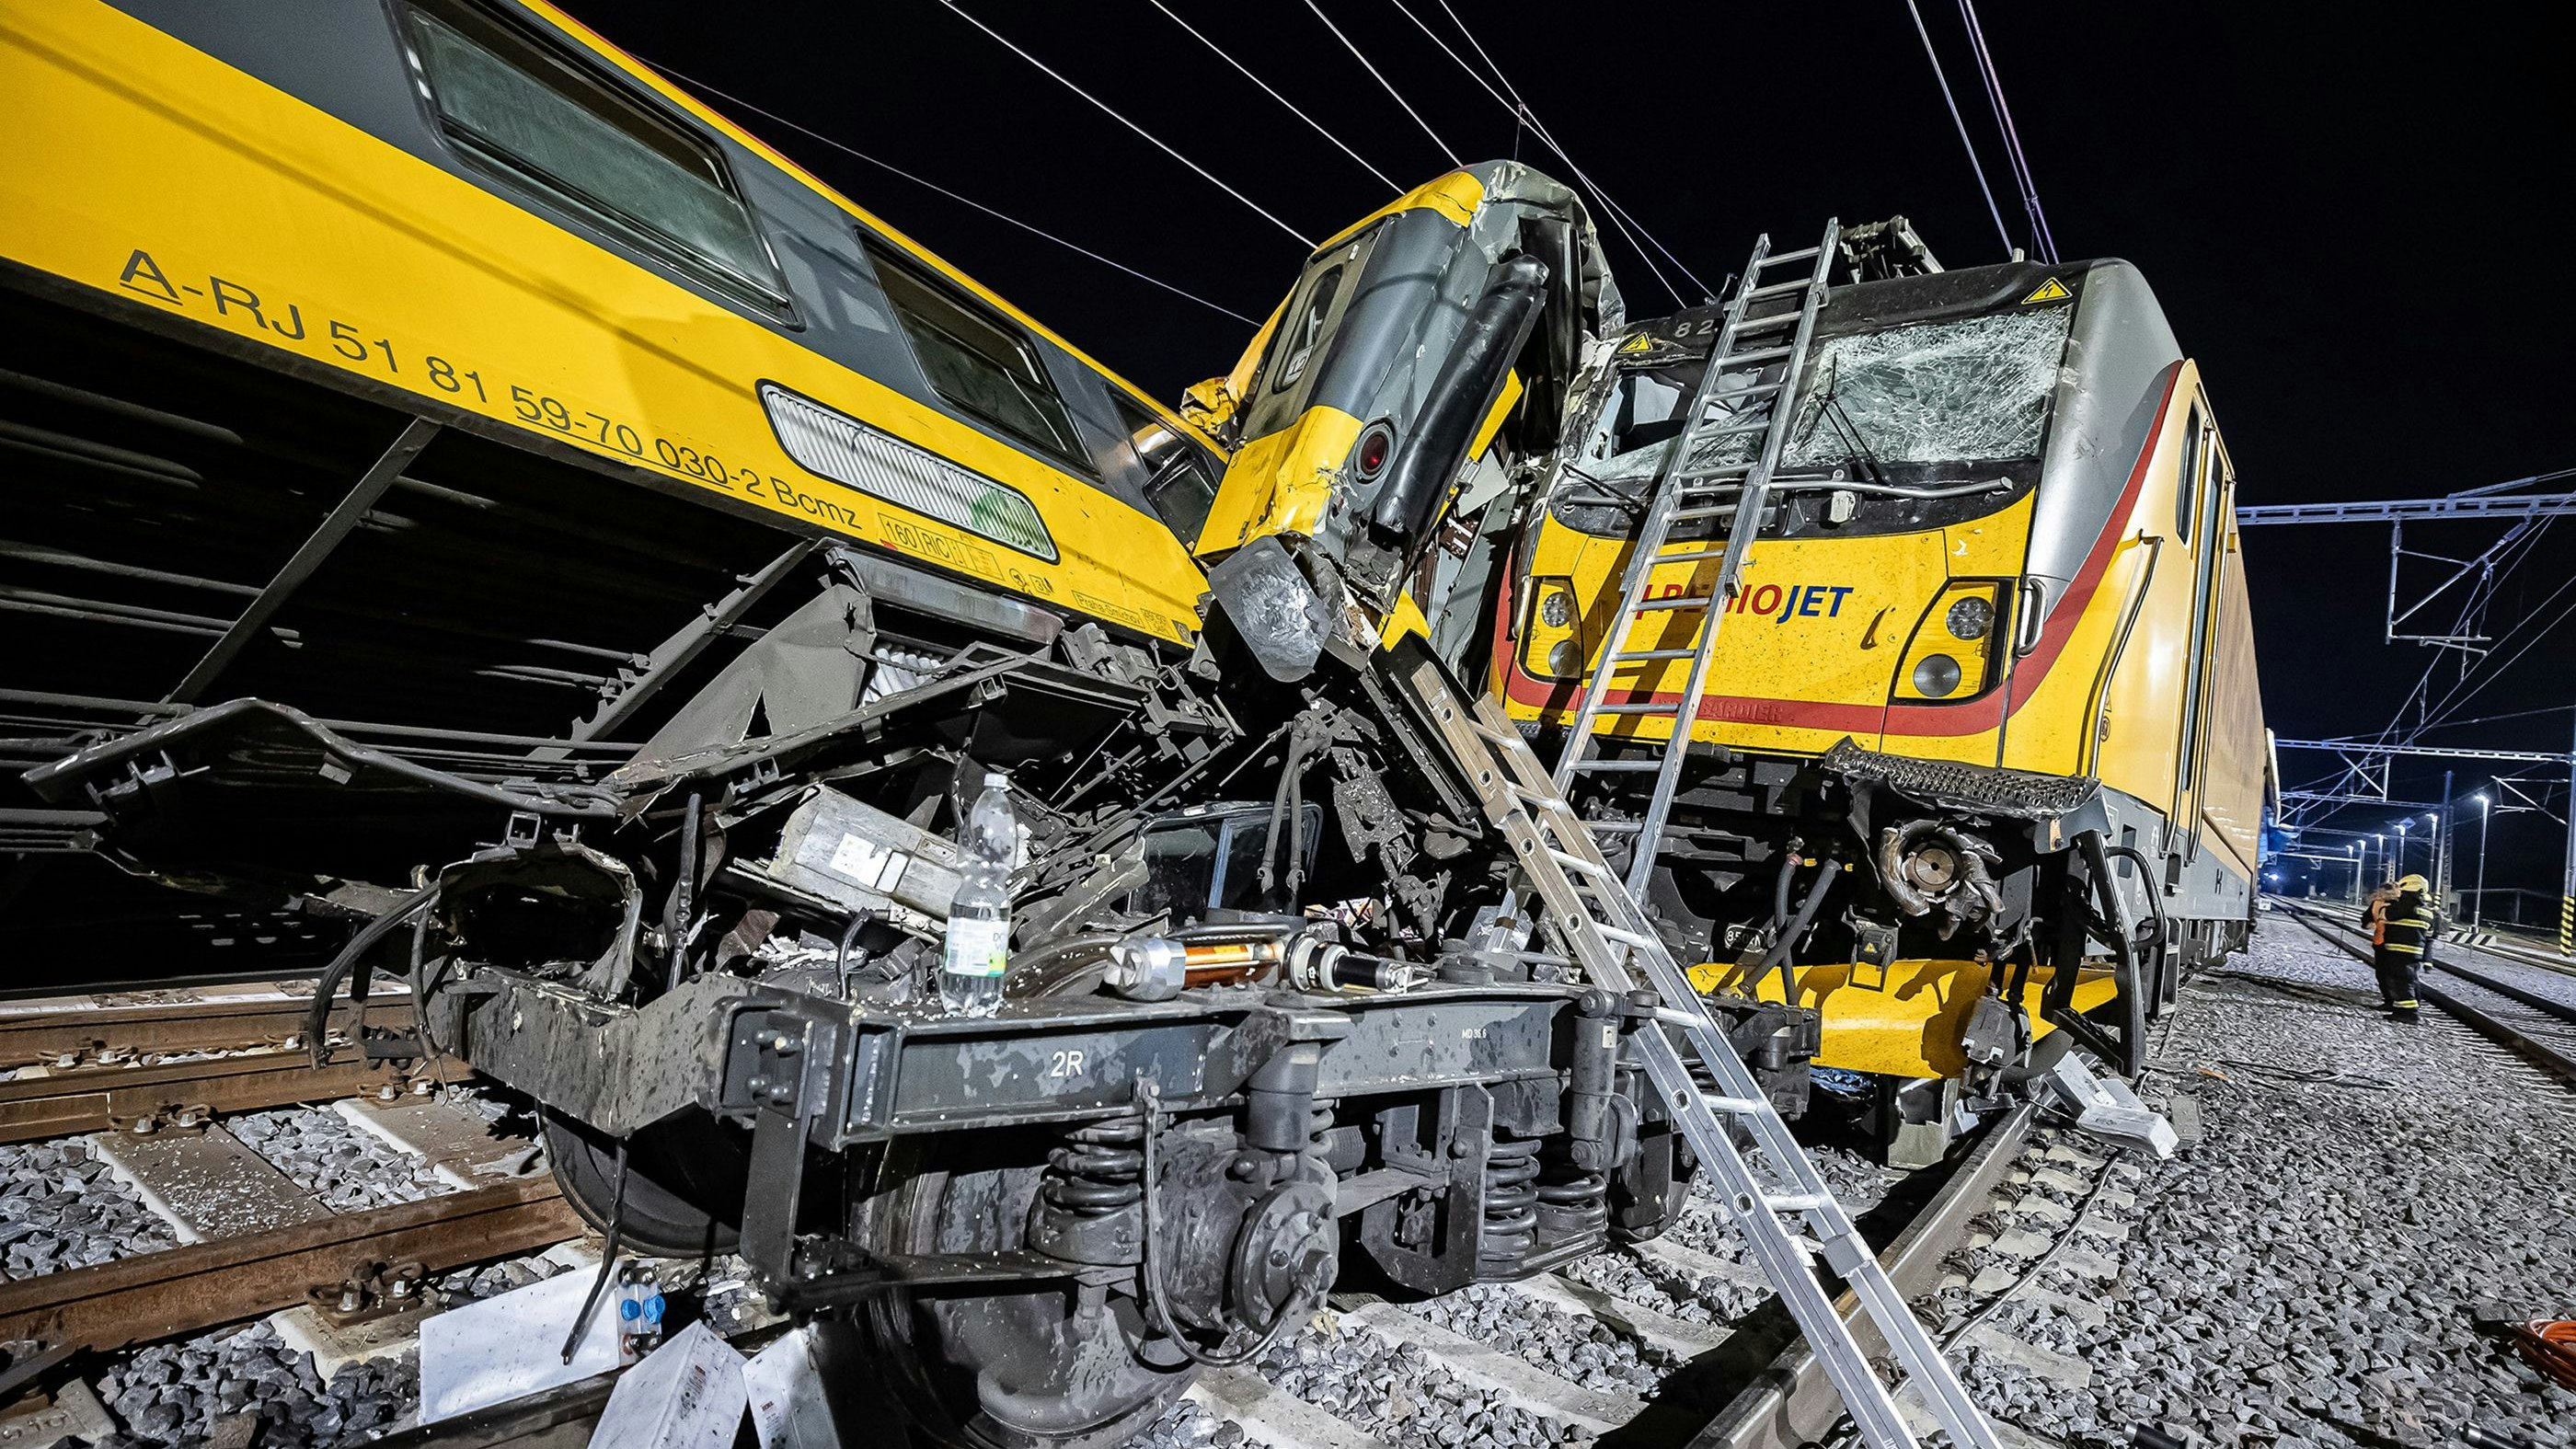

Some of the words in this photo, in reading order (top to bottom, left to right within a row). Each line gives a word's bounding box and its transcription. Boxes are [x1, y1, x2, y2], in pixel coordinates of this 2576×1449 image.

[120, 248, 305, 340] A-RJ
[329, 319, 398, 374] 51
[425, 355, 488, 403] 81
[511, 385, 644, 458] 59-70
[655, 437, 766, 499] 030-2
[769, 476, 863, 531] Bcmz
[886, 521, 918, 549] 160
[922, 532, 950, 559] RIC
[1636, 583, 1855, 625] REIOJET
[1051, 1050, 1084, 1077] 2R
